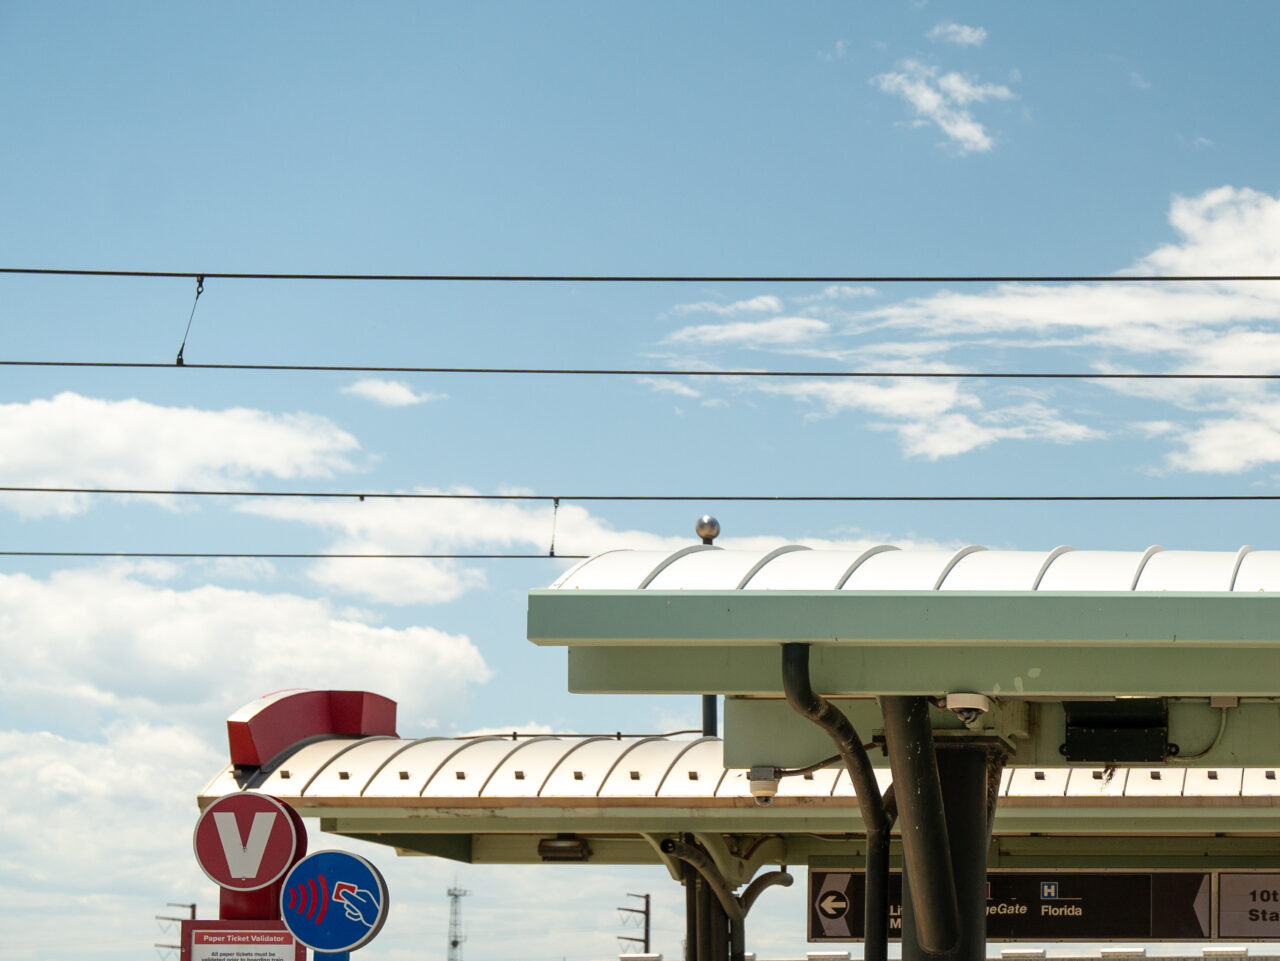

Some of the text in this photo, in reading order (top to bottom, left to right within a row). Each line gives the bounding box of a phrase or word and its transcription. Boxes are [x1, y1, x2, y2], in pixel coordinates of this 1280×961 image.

[212, 811, 278, 879] V
[1043, 885, 1056, 896] H
[1041, 905, 1083, 916] Florida
[203, 935, 225, 943] Paper
